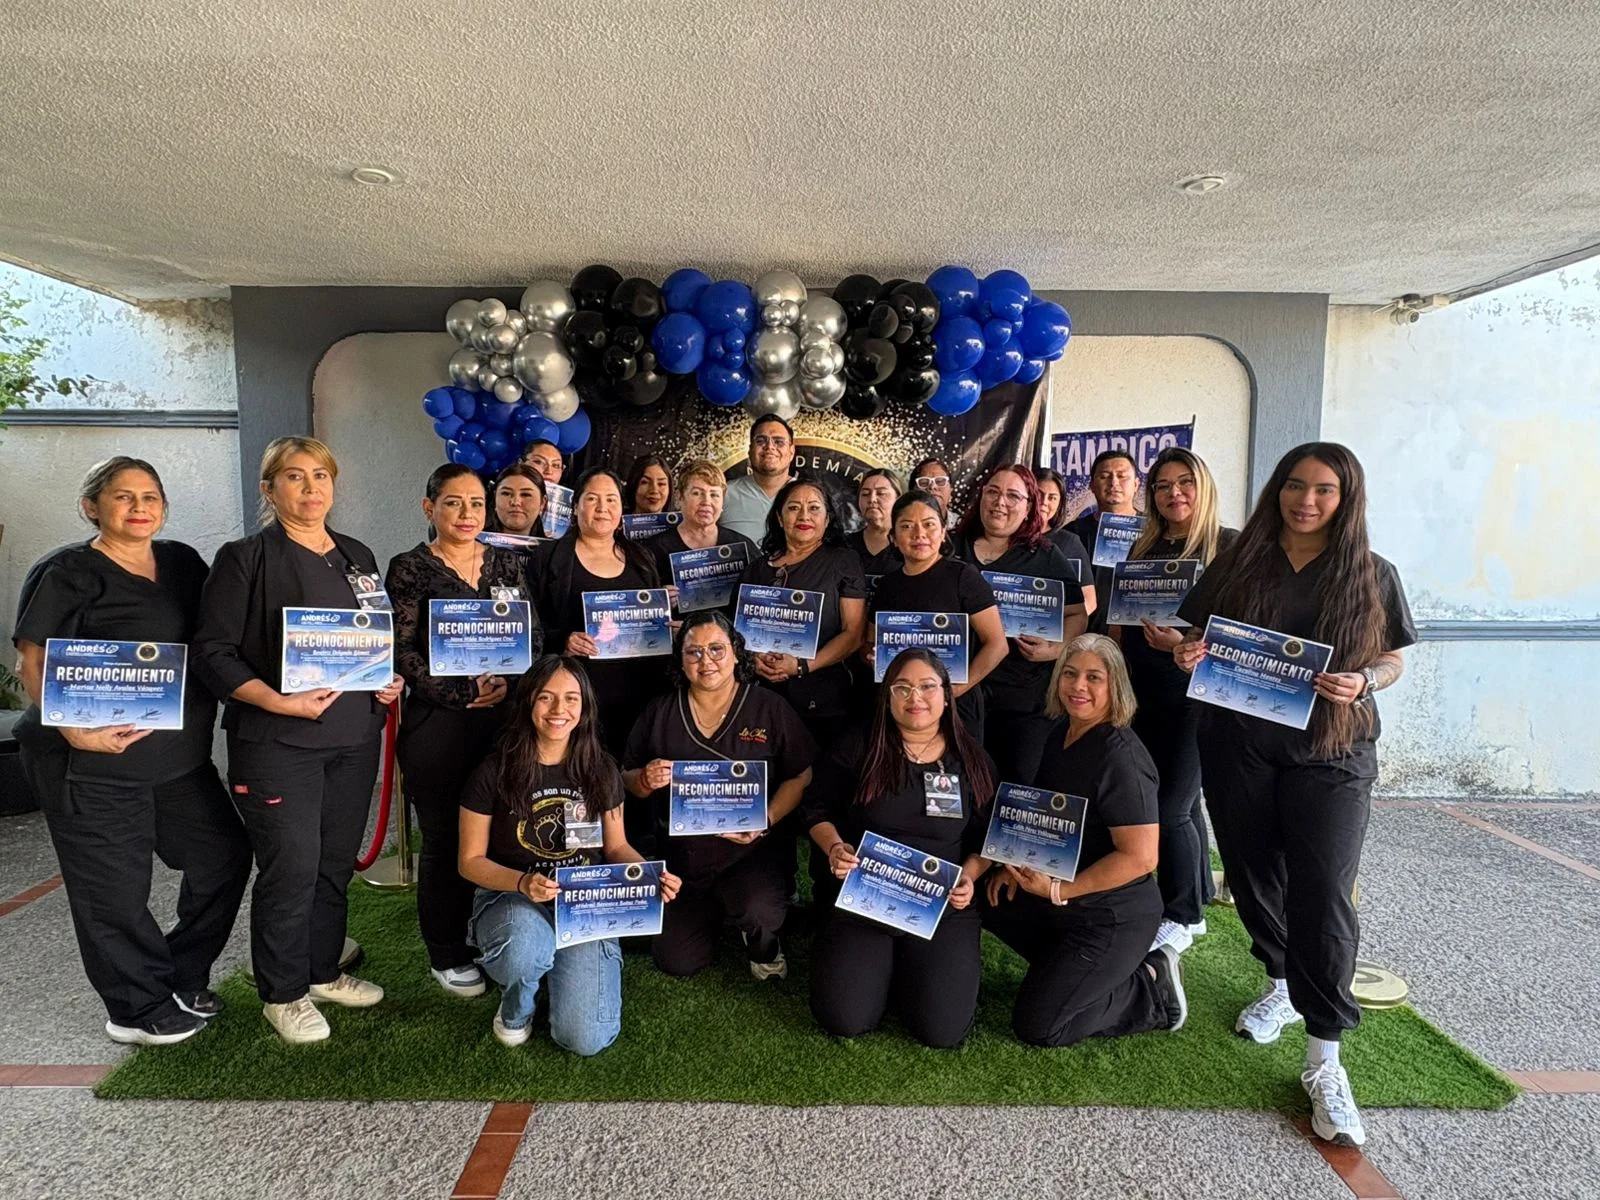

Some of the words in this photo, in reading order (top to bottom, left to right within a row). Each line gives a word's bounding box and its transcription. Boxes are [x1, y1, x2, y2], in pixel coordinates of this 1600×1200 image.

[746, 456, 865, 482] ADEMIA
[1103, 527, 1143, 541] RECONOCI
[679, 560, 745, 580] RECONOCIMIENTO
[1119, 579, 1188, 591] RECONOCIMIENTO
[993, 590, 1058, 607] ECONOCIMIENTO
[592, 607, 665, 622] RECONOCIMIENTO
[743, 604, 815, 623] RECONOCIMIENTO
[438, 621, 524, 635] RECONOCIMIENTO
[295, 634, 385, 648] RECONOCIMIENTO
[883, 632, 962, 646] RECONOCIMIENTO
[1210, 642, 1314, 682] RECONOCIMIENTO
[56, 666, 175, 684] RECONOCIMIENTO
[543, 787, 559, 797] son
[560, 788, 573, 797] un
[679, 783, 760, 796] RECONOCIMIENTO
[1000, 805, 1076, 834] RECONOCIMIENTO
[860, 856, 946, 898] RECONOCIMIENTO
[565, 884, 657, 903] RECONOCIMIENTO
